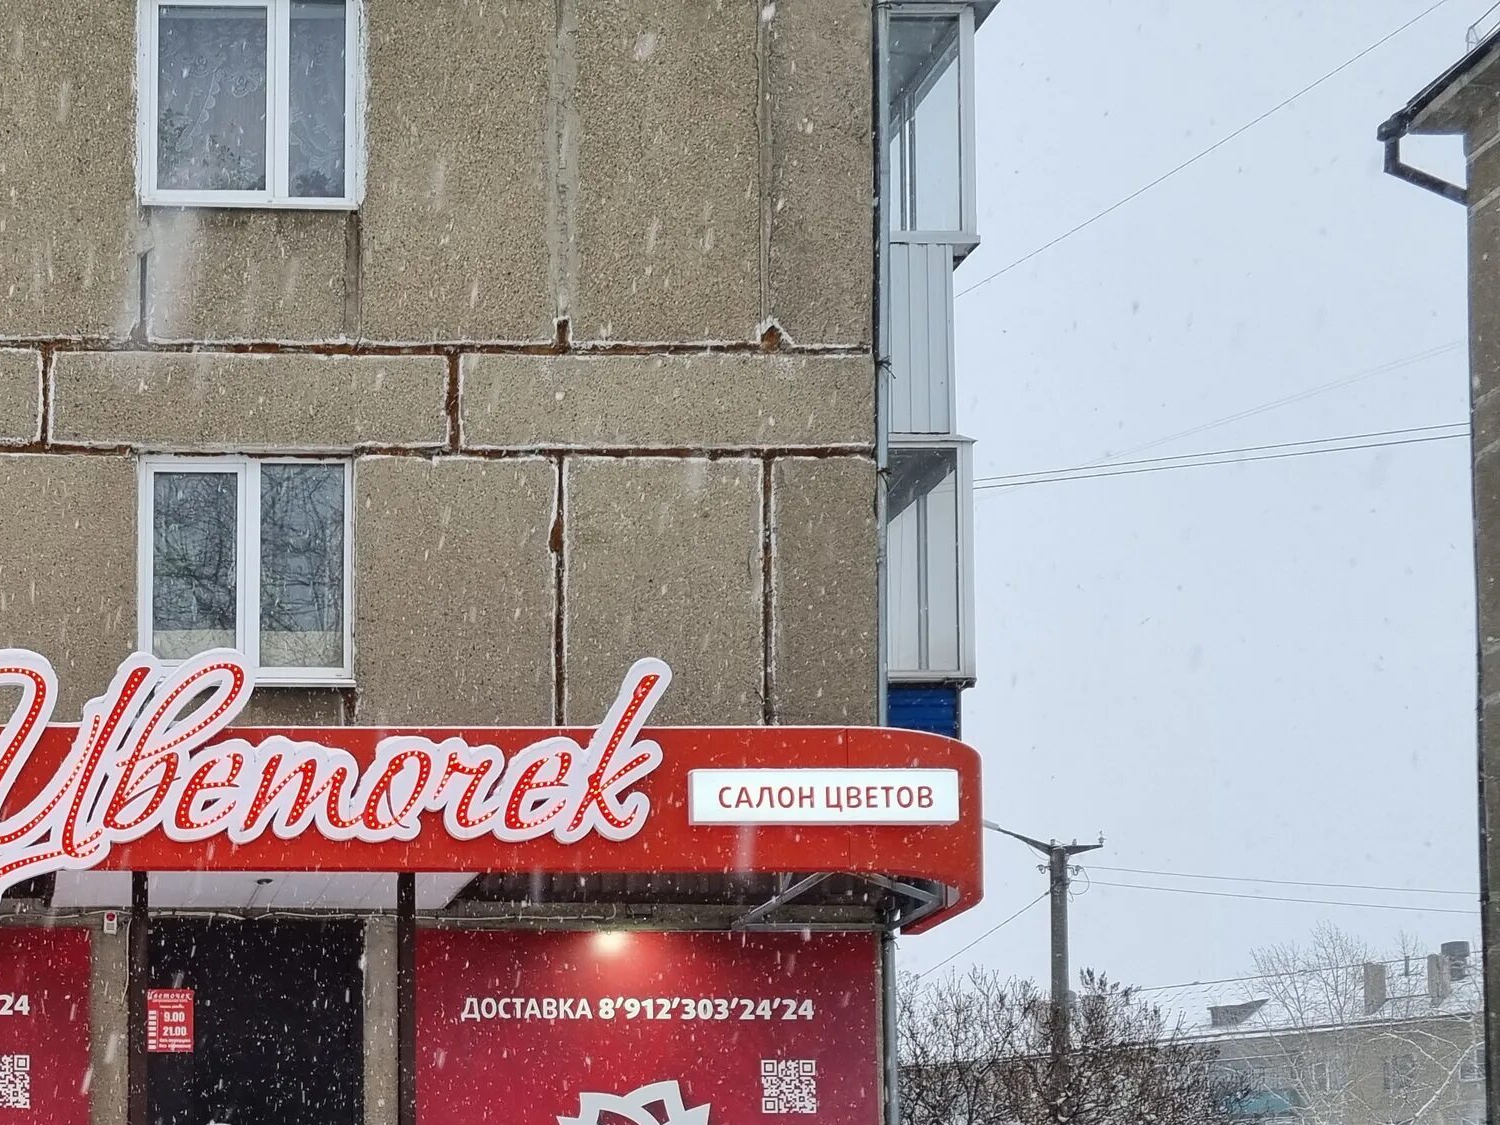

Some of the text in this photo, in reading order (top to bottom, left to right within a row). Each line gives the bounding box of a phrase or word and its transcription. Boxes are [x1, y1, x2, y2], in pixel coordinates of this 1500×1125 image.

[718, 786, 934, 812] САЛОН ЦВЕТОВ
[164, 1011, 185, 1022] 9.00
[461, 998, 593, 1021] ДОСТАВКА
[163, 1026, 187, 1036] 21.00
